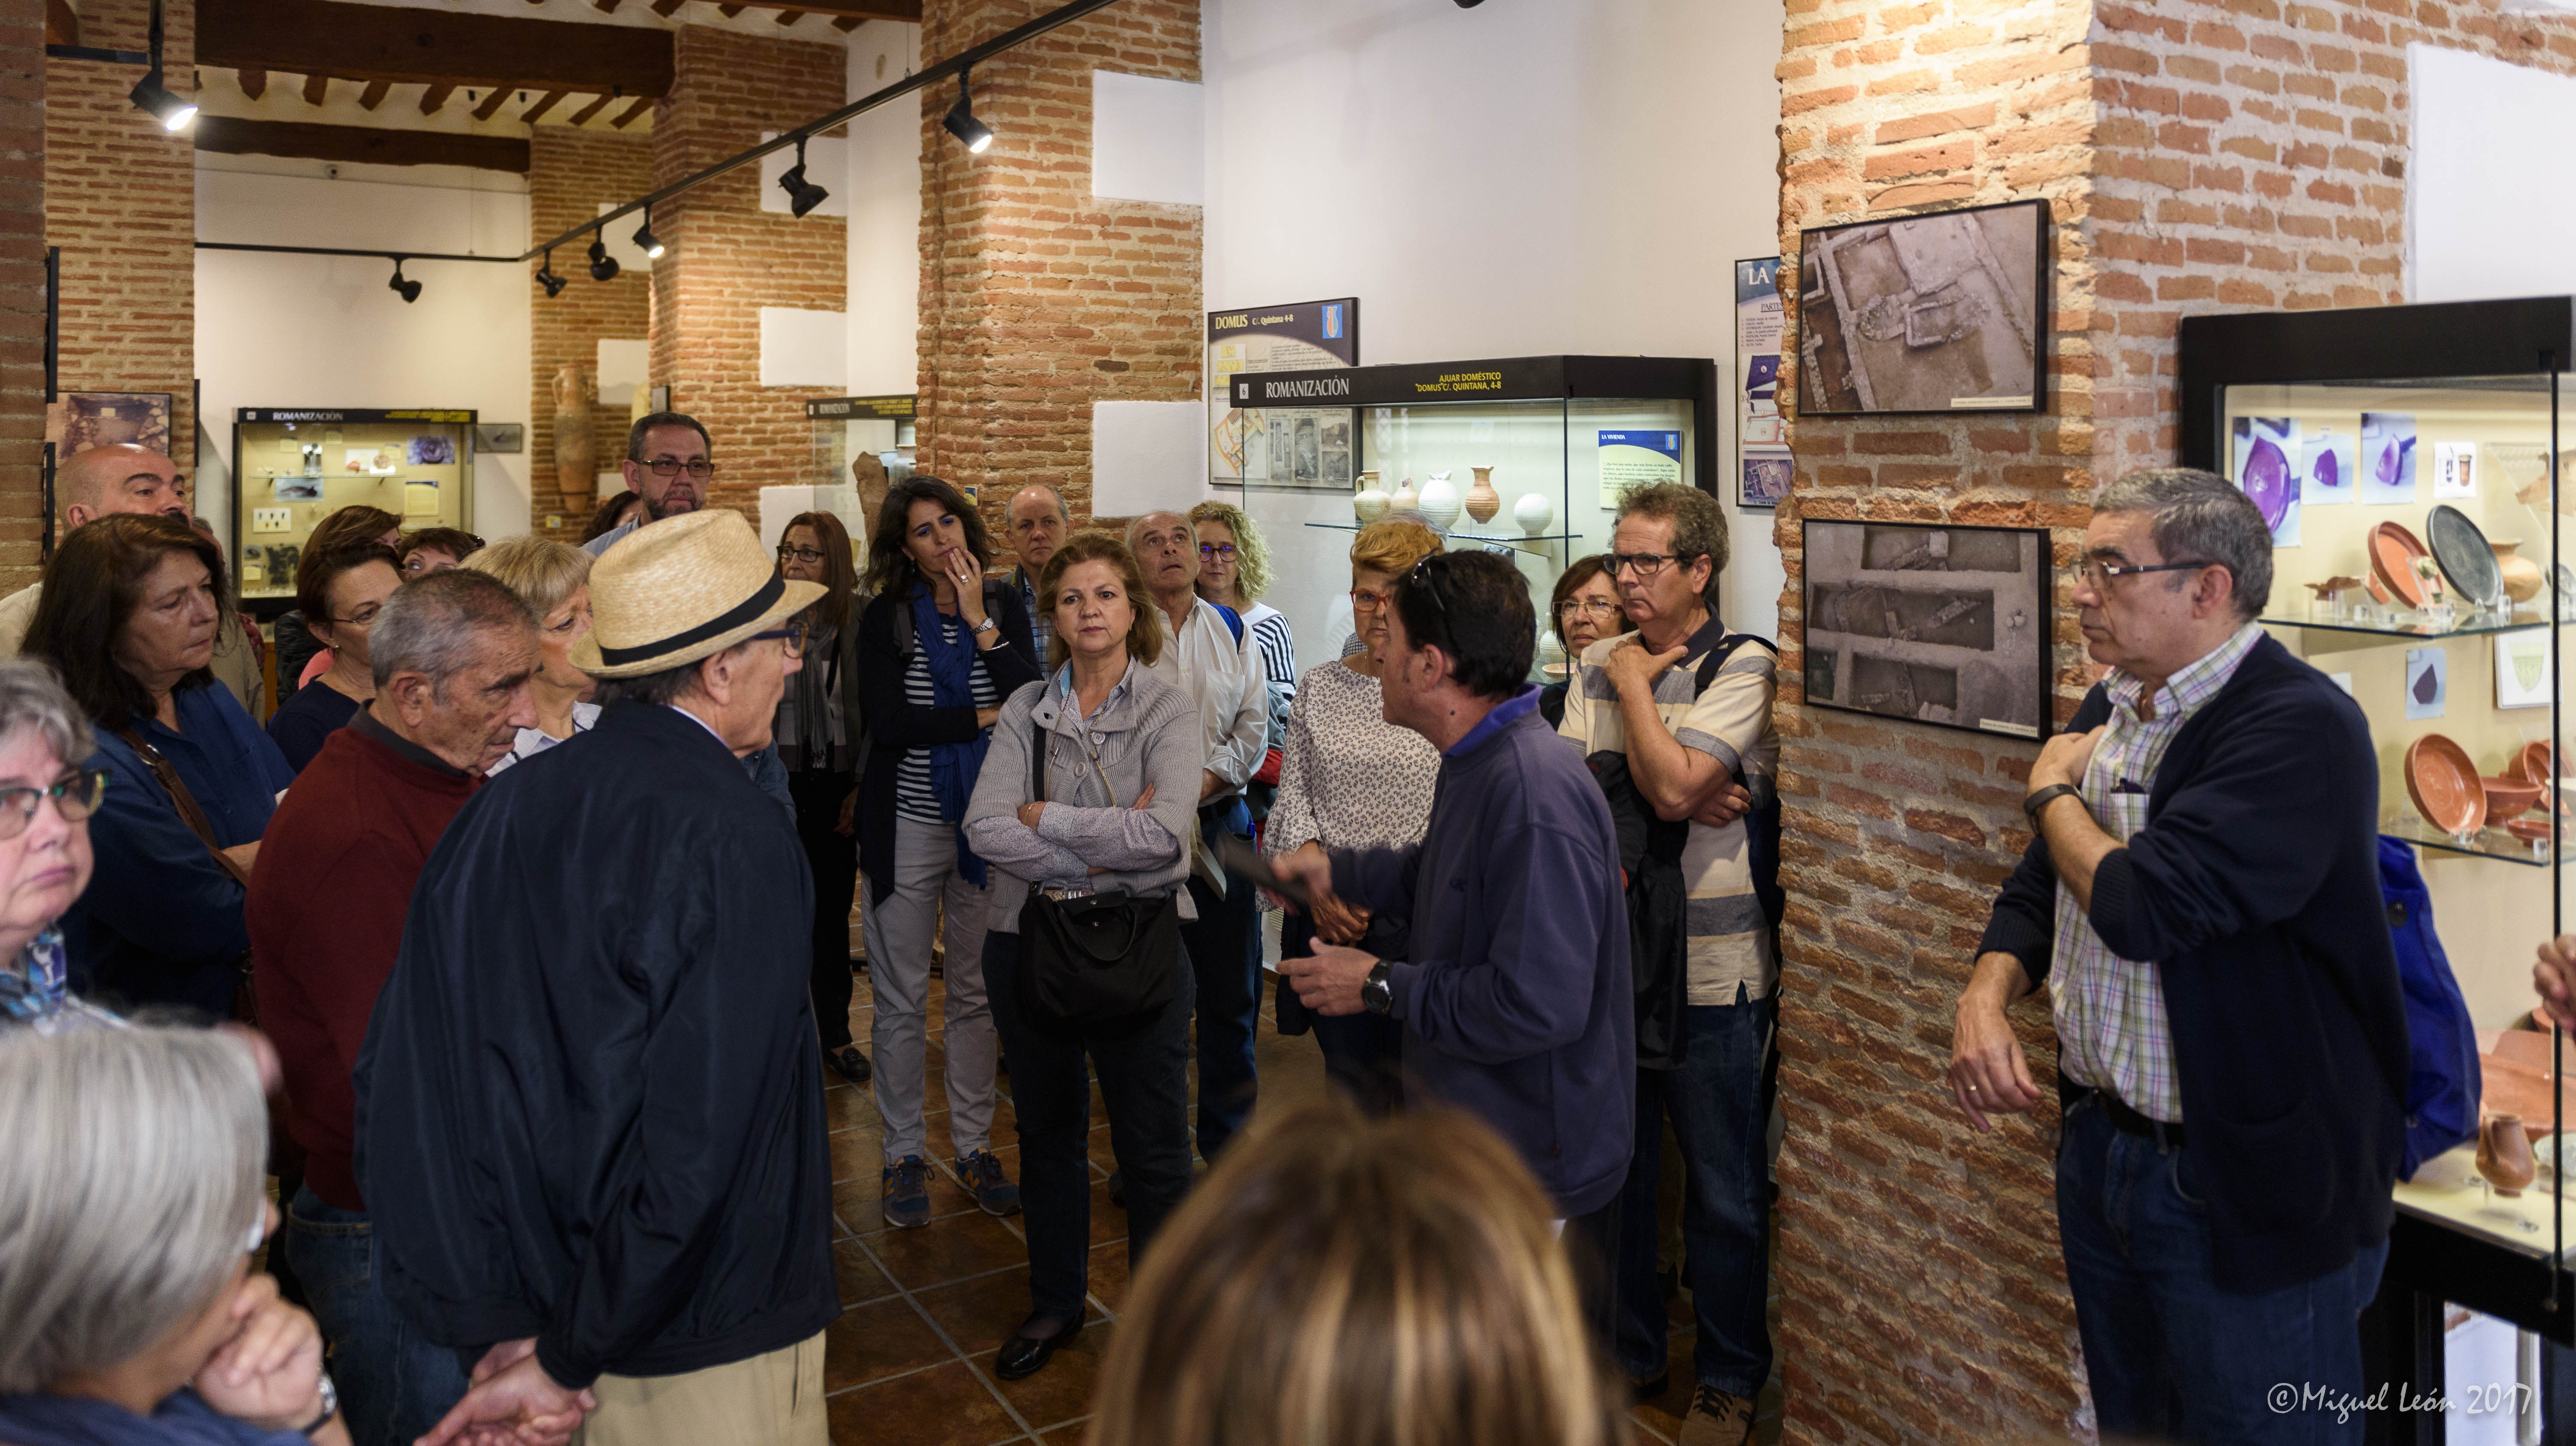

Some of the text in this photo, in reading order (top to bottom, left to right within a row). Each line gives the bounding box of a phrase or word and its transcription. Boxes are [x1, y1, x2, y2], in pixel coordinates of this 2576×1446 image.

[1749, 267, 1770, 285] LA
[1215, 314, 1248, 329] DOMUS
[1261, 316, 1284, 326] Quintana
[1439, 371, 1501, 382] AJUAR DOMÉSTICO
[1242, 387, 1246, 395] 6
[1266, 375, 1349, 398] ROMANIZACIÓN
[1453, 382, 1489, 391] QUINTANA,
[273, 411, 343, 421] ROMANIZACIÓN
